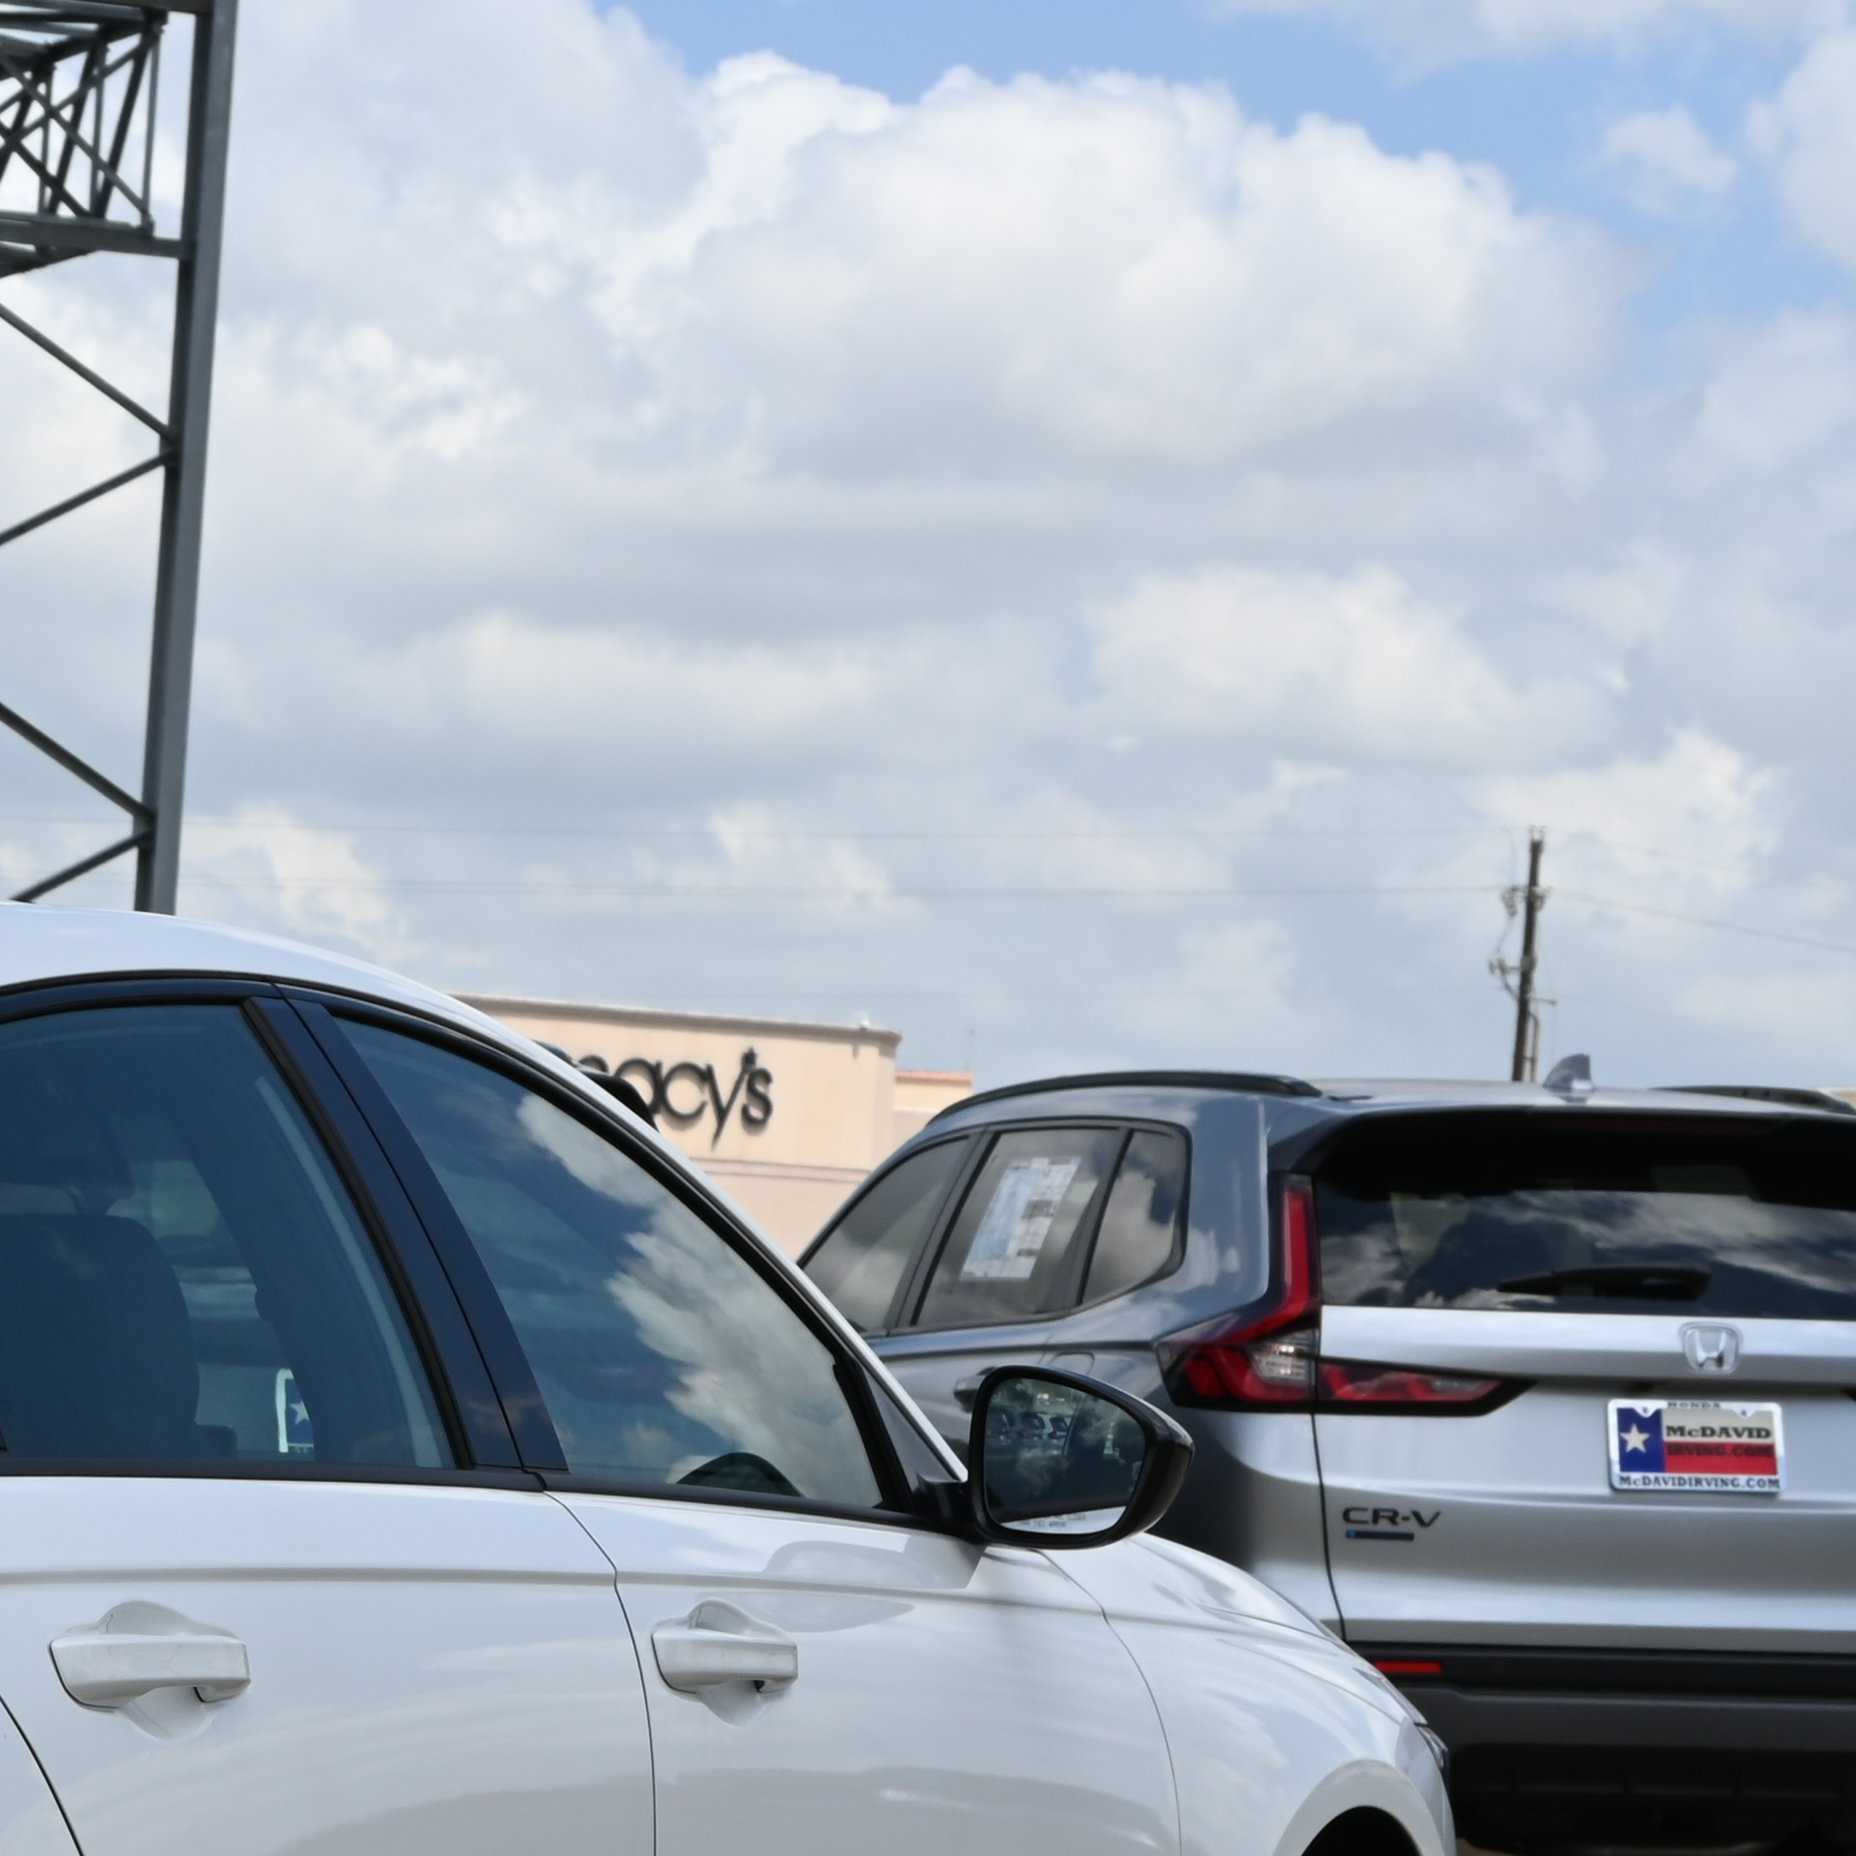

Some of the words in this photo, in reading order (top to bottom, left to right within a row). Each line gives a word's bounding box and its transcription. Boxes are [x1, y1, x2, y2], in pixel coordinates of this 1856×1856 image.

[578, 1046, 774, 1149] acy's
[1666, 1425, 1772, 1439] McDAVID
[1619, 1475, 1781, 1489] McDAVIDIRVING.COM
[1342, 1507, 1442, 1528] CR-V
